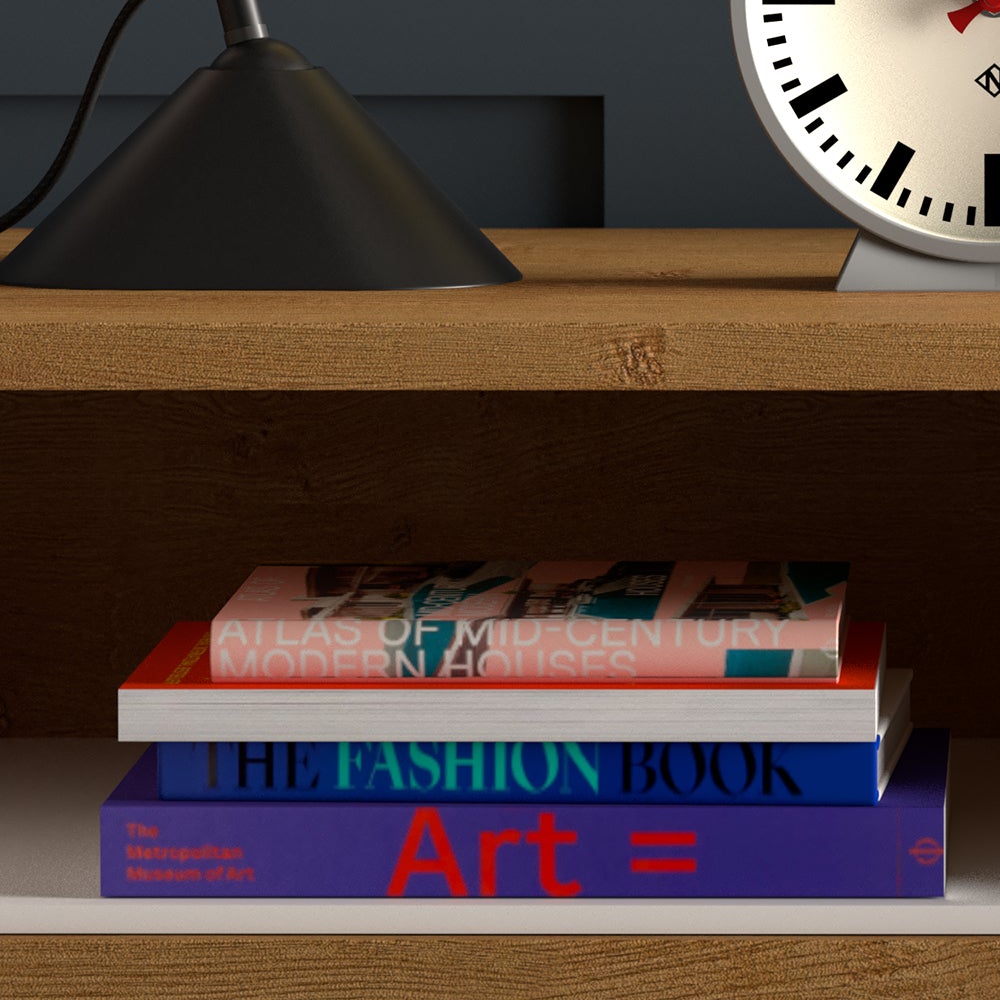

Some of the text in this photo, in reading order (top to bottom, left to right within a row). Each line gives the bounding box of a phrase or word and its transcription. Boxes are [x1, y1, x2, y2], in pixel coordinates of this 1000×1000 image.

[217, 619, 790, 647] ATLAS OF MID-CENTURY
[218, 649, 426, 678] MODERN
[443, 649, 637, 678] HOUSES
[191, 742, 803, 796] THE FASHION BOOK
[126, 823, 160, 839] The
[126, 845, 244, 862] Metropolitan
[386, 806, 583, 897] Art
[126, 866, 202, 882] Museum
[226, 866, 256, 882] Art
